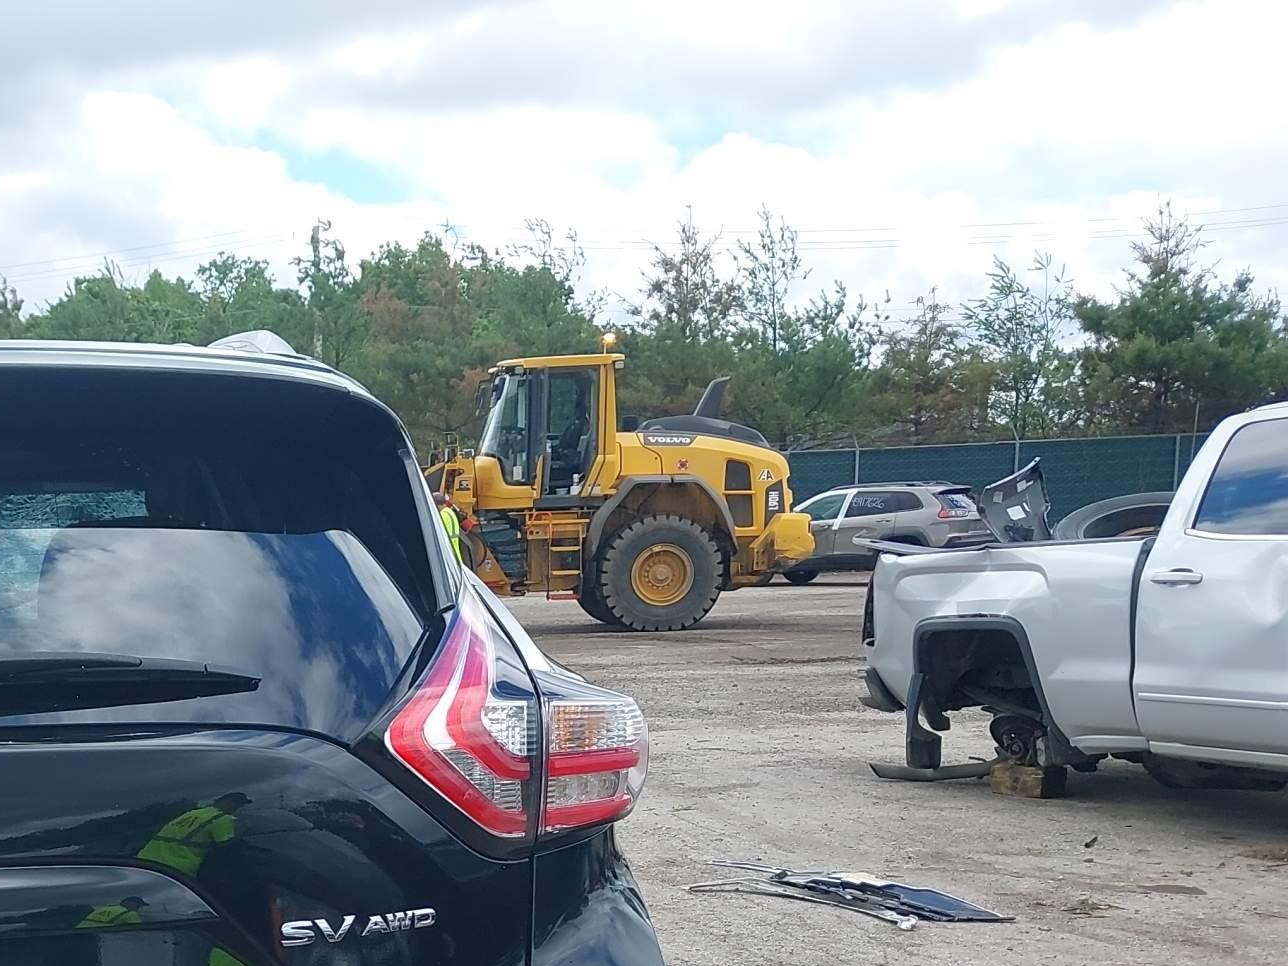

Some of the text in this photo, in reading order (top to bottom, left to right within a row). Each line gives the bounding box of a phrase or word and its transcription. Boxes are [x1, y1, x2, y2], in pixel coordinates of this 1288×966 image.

[647, 436, 691, 444] VOLVO
[280, 906, 437, 948] SV AWD
